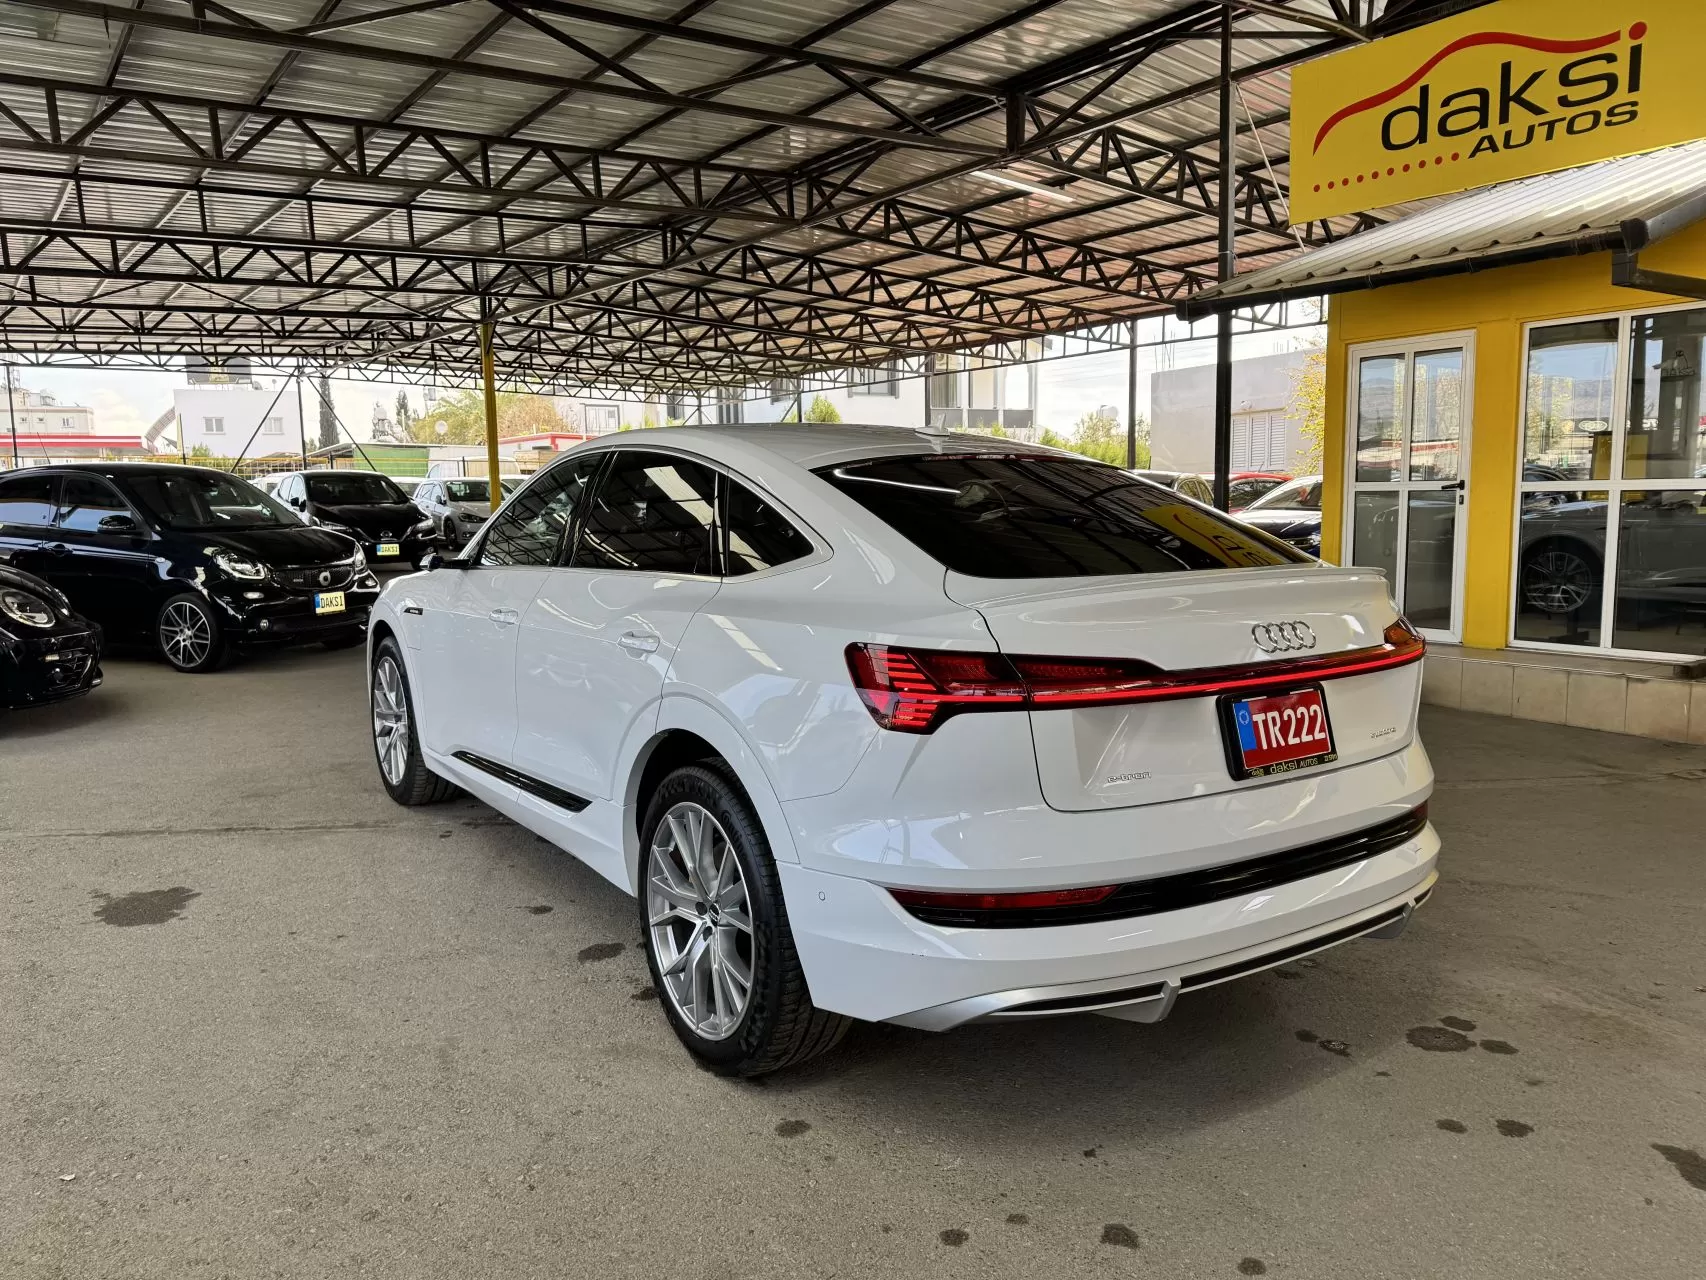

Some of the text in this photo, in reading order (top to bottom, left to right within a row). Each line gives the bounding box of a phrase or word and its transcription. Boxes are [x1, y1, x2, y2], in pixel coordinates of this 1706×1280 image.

[1381, 21, 1647, 151] daksi
[1468, 101, 1639, 159] AUTOS
[320, 595, 343, 609] DAKSI
[1300, 757, 1319, 769] AUTOS
